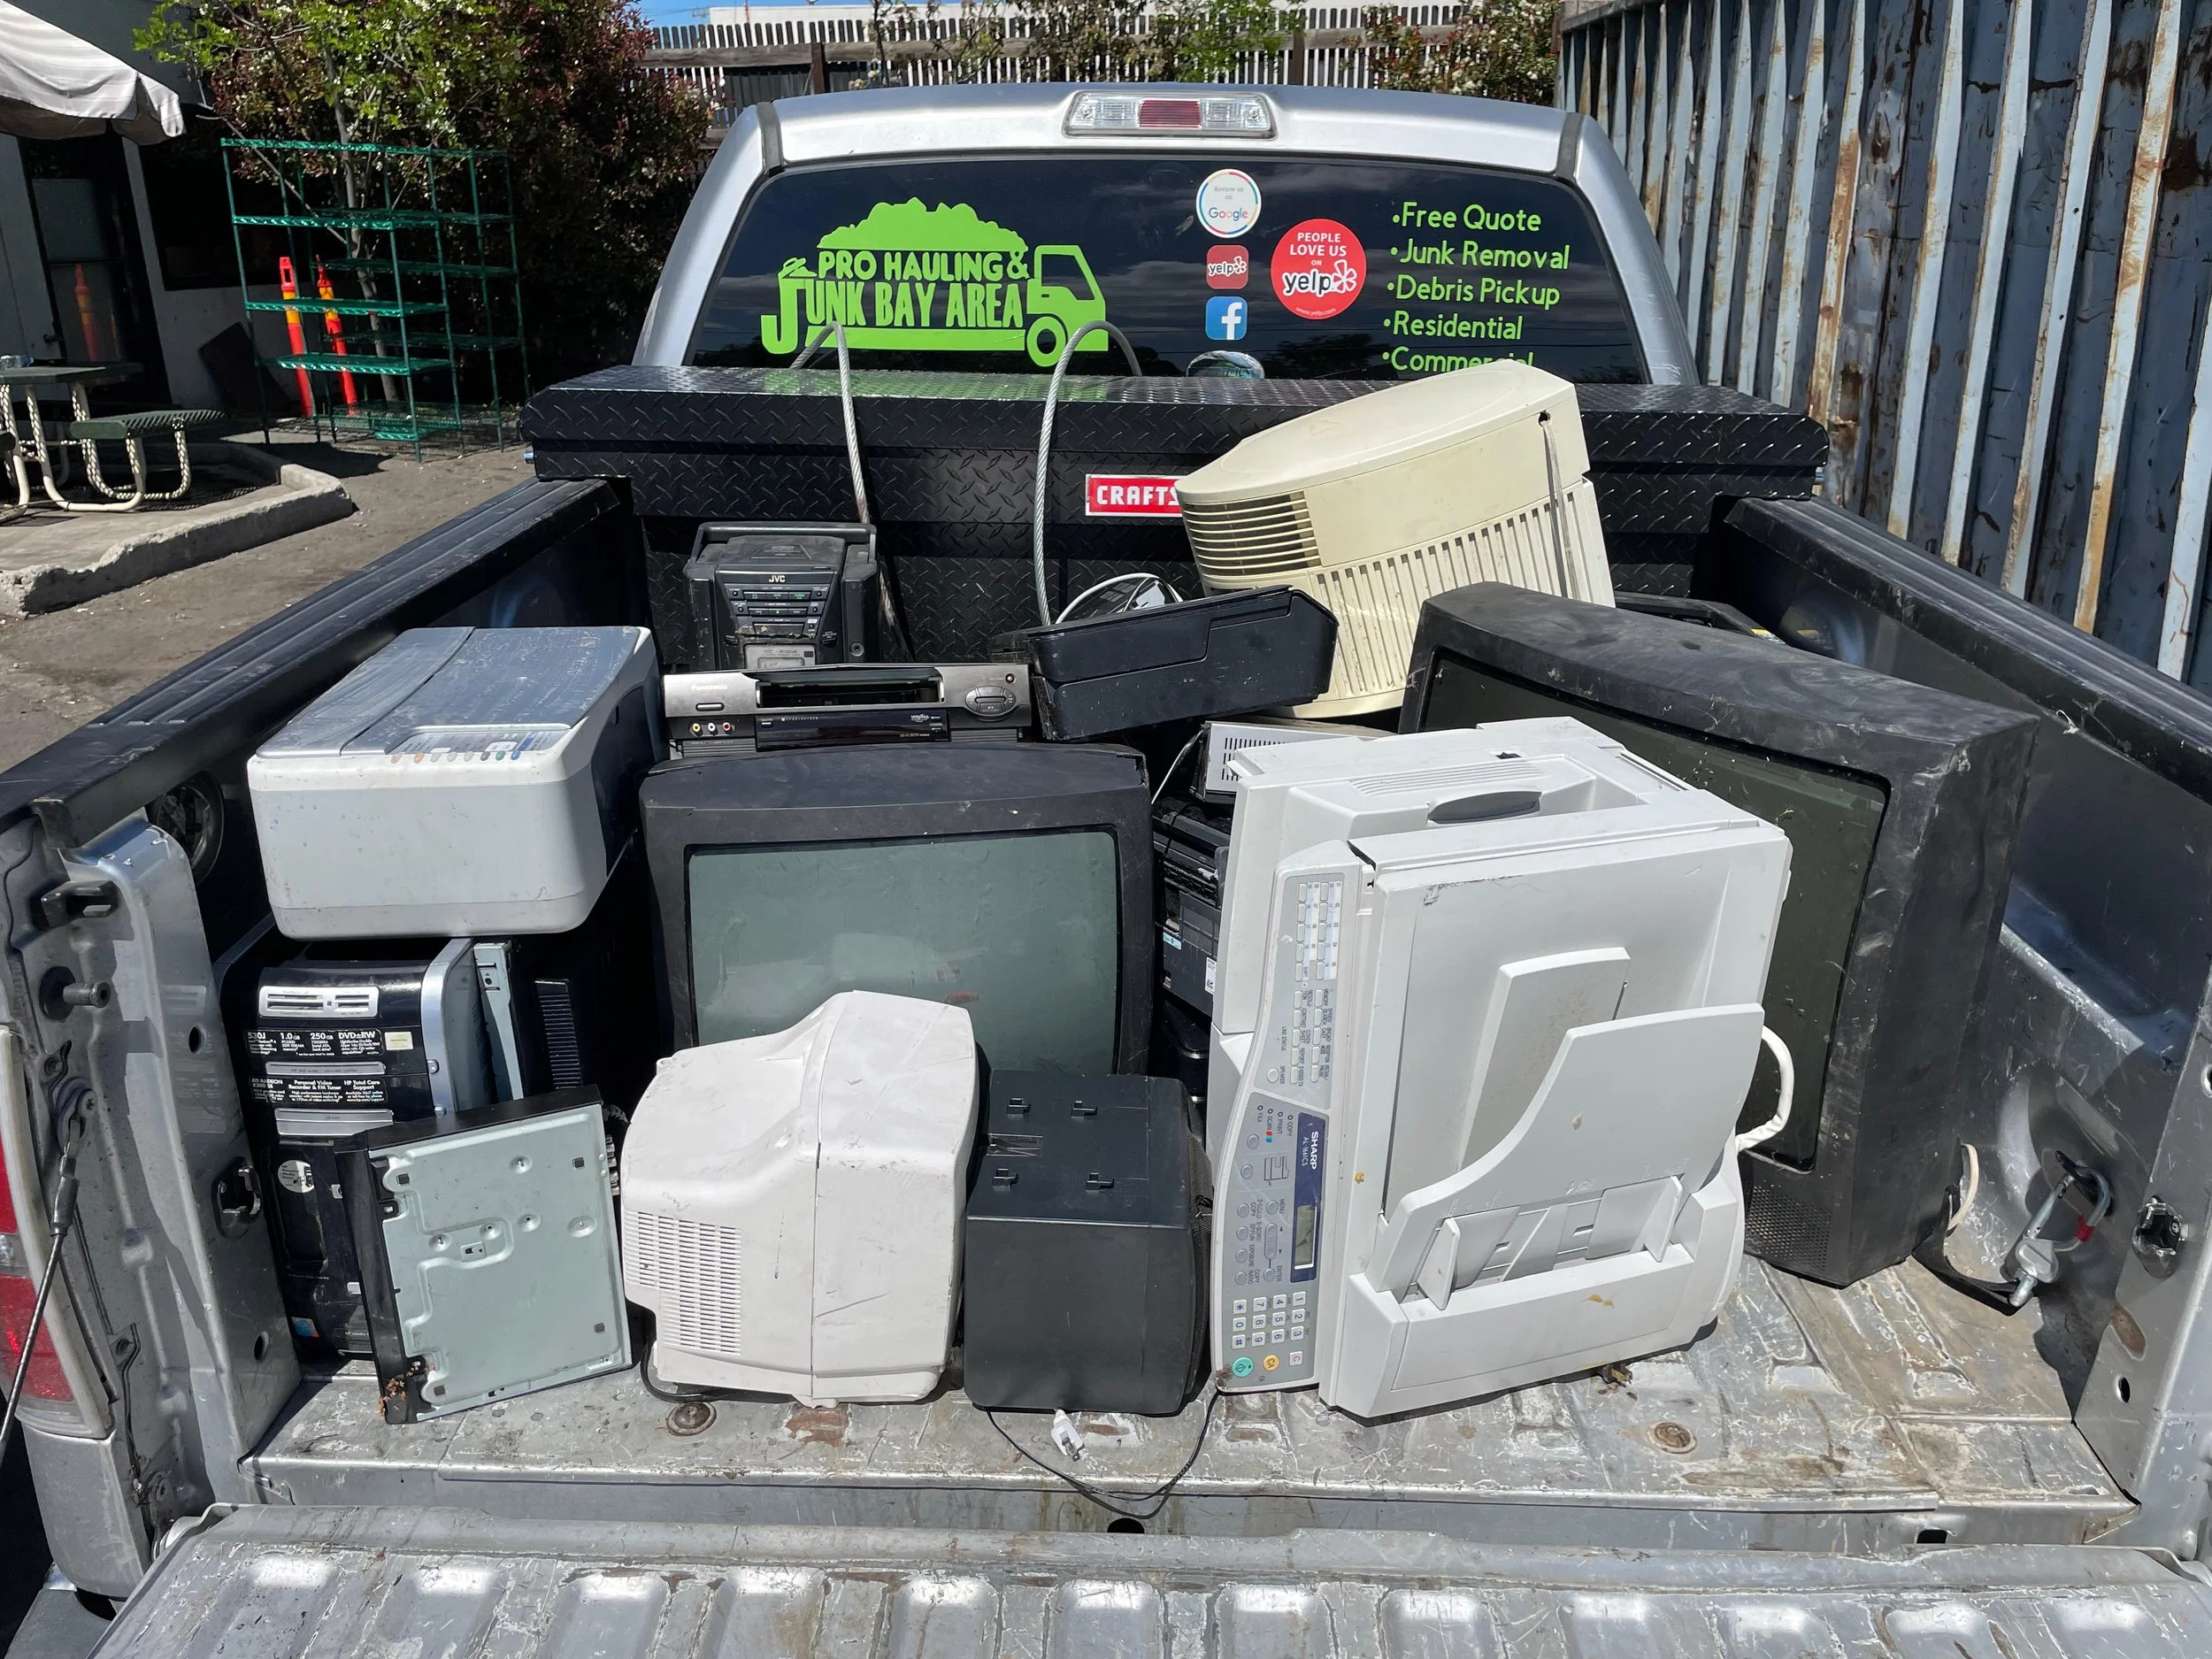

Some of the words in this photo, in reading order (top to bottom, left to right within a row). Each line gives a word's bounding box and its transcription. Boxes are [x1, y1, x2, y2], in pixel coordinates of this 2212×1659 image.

[1209, 207, 1248, 221] Google
[1402, 202, 1457, 228] Free
[1463, 204, 1541, 233] Quote
[1289, 244, 1325, 256] LOVE
[1329, 245, 1347, 257] US
[1297, 232, 1341, 242] PEOPLE
[818, 250, 877, 280] PRO
[884, 252, 1003, 282] HAULING
[1006, 250, 1030, 280] &
[1208, 259, 1233, 277] yelp
[1400, 238, 1455, 265] Junk
[1463, 240, 1571, 269] Removal
[1282, 268, 1332, 297] yelp
[1396, 274, 1474, 303] Debris
[1479, 277, 1561, 311] Pickup
[760, 276, 867, 355] JUNK
[875, 282, 935, 326] BAY
[946, 282, 1023, 328] AREA
[1393, 310, 1523, 340] Residential
[1267, 1358, 1275, 1369] CA
